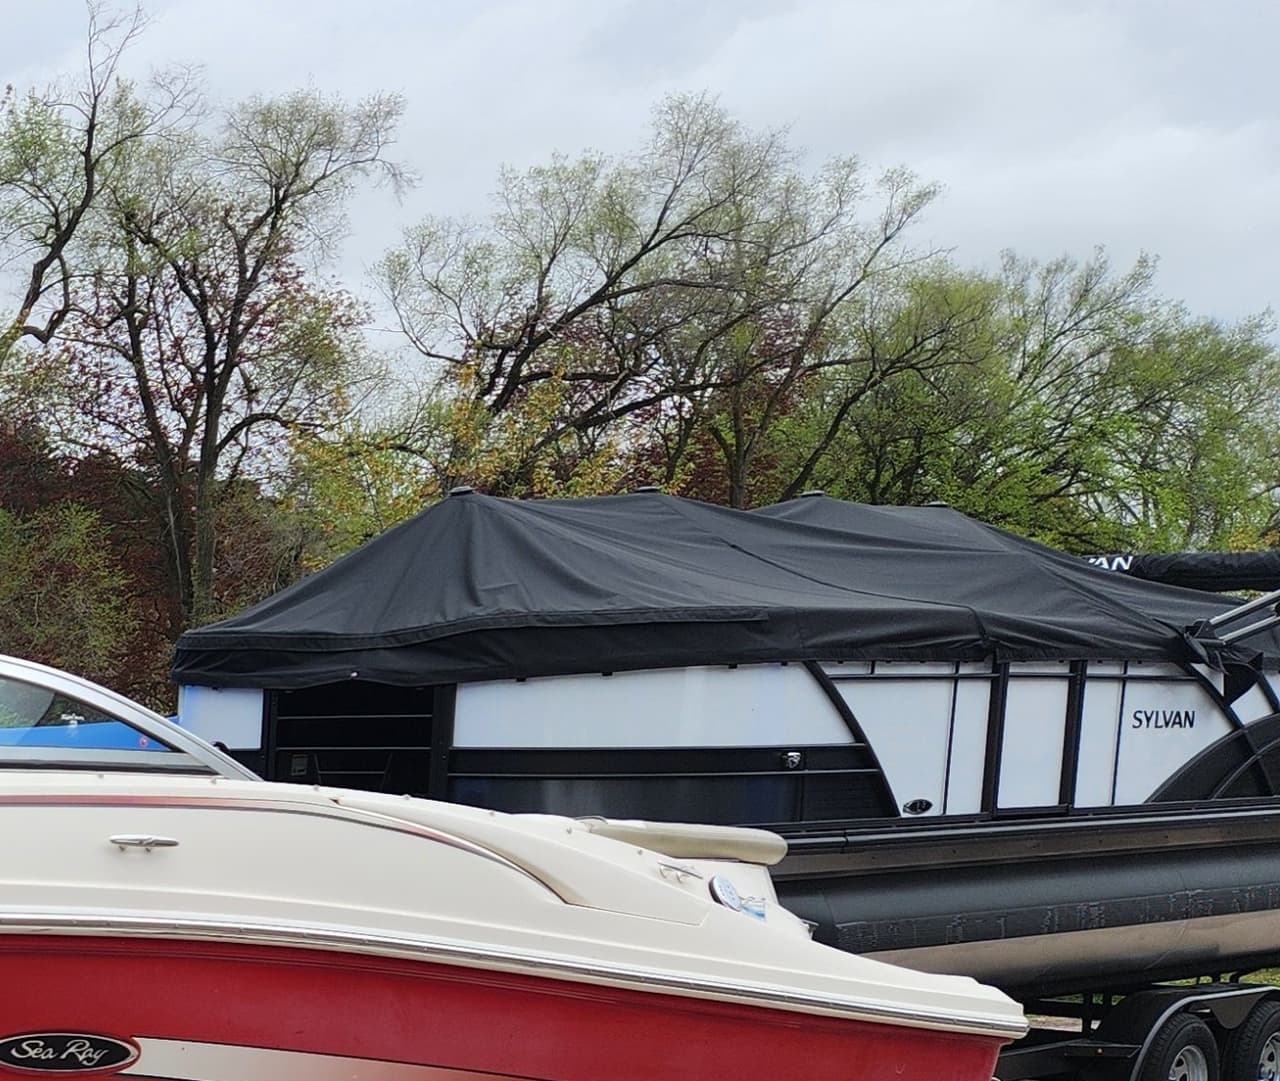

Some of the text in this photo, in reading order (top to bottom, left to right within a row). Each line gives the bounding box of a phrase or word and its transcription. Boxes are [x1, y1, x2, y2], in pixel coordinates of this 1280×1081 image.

[1131, 709, 1196, 729] SYLVAN
[9, 1038, 110, 1066] Sea Ray
